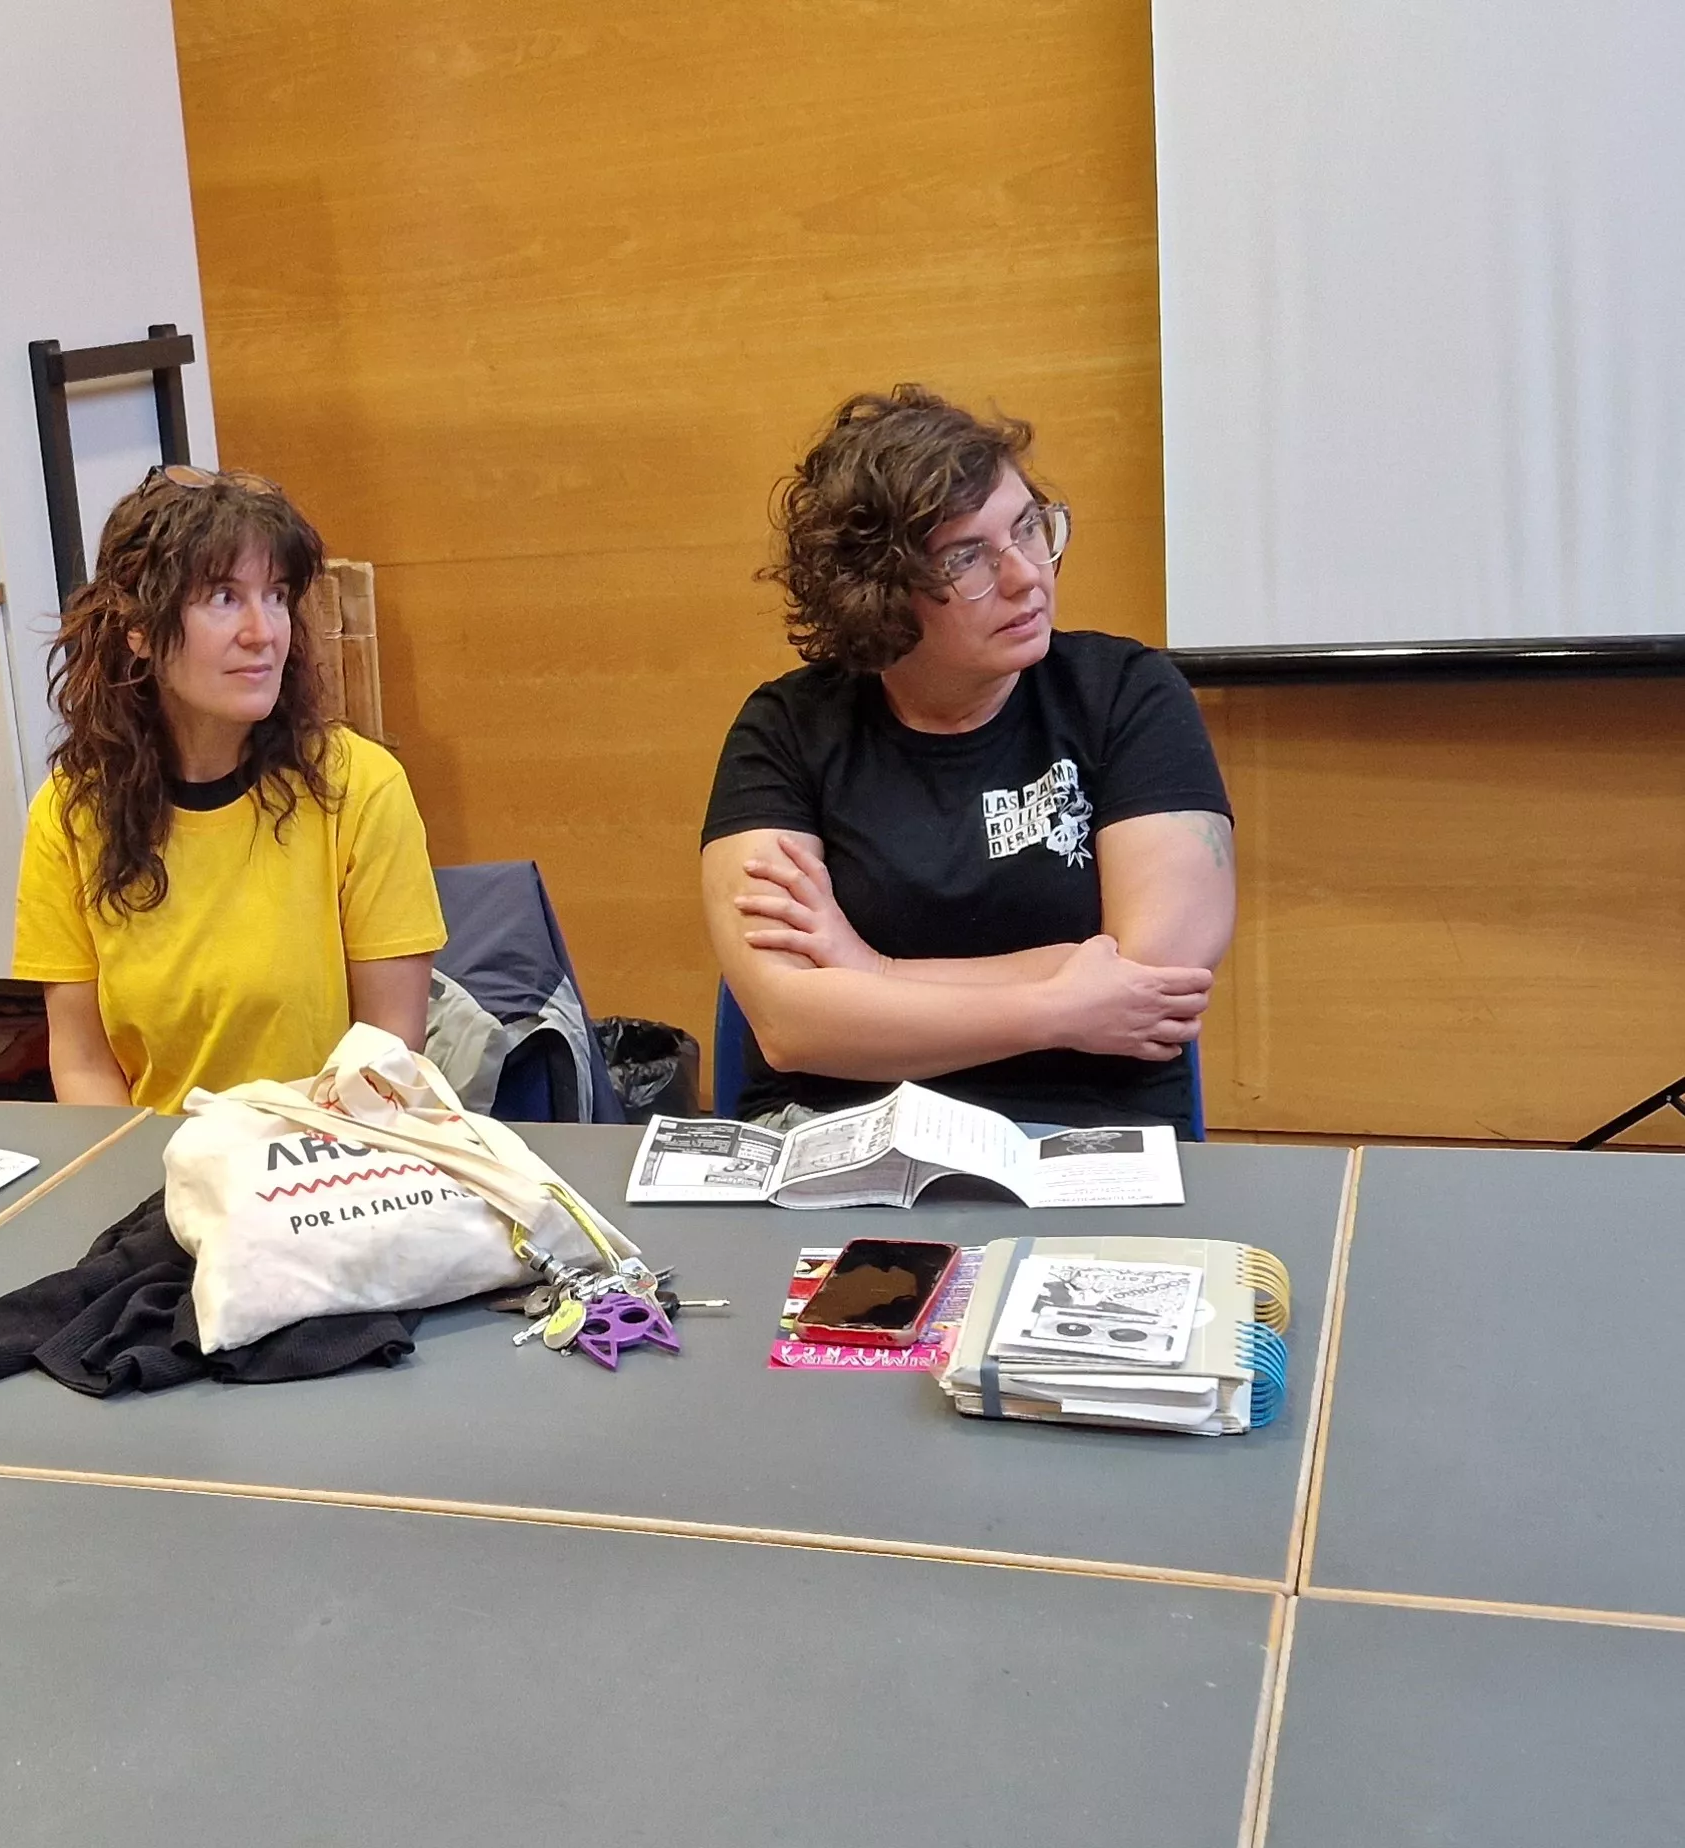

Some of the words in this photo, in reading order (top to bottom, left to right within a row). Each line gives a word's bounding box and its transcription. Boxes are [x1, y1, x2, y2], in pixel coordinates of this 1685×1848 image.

[984, 795, 1019, 815] LAS
[989, 797, 1054, 837] ROLLER
[991, 820, 1047, 856] DERBY
[289, 1210, 335, 1235] POR
[338, 1204, 367, 1221] LA
[370, 1189, 435, 1216] SALUD
